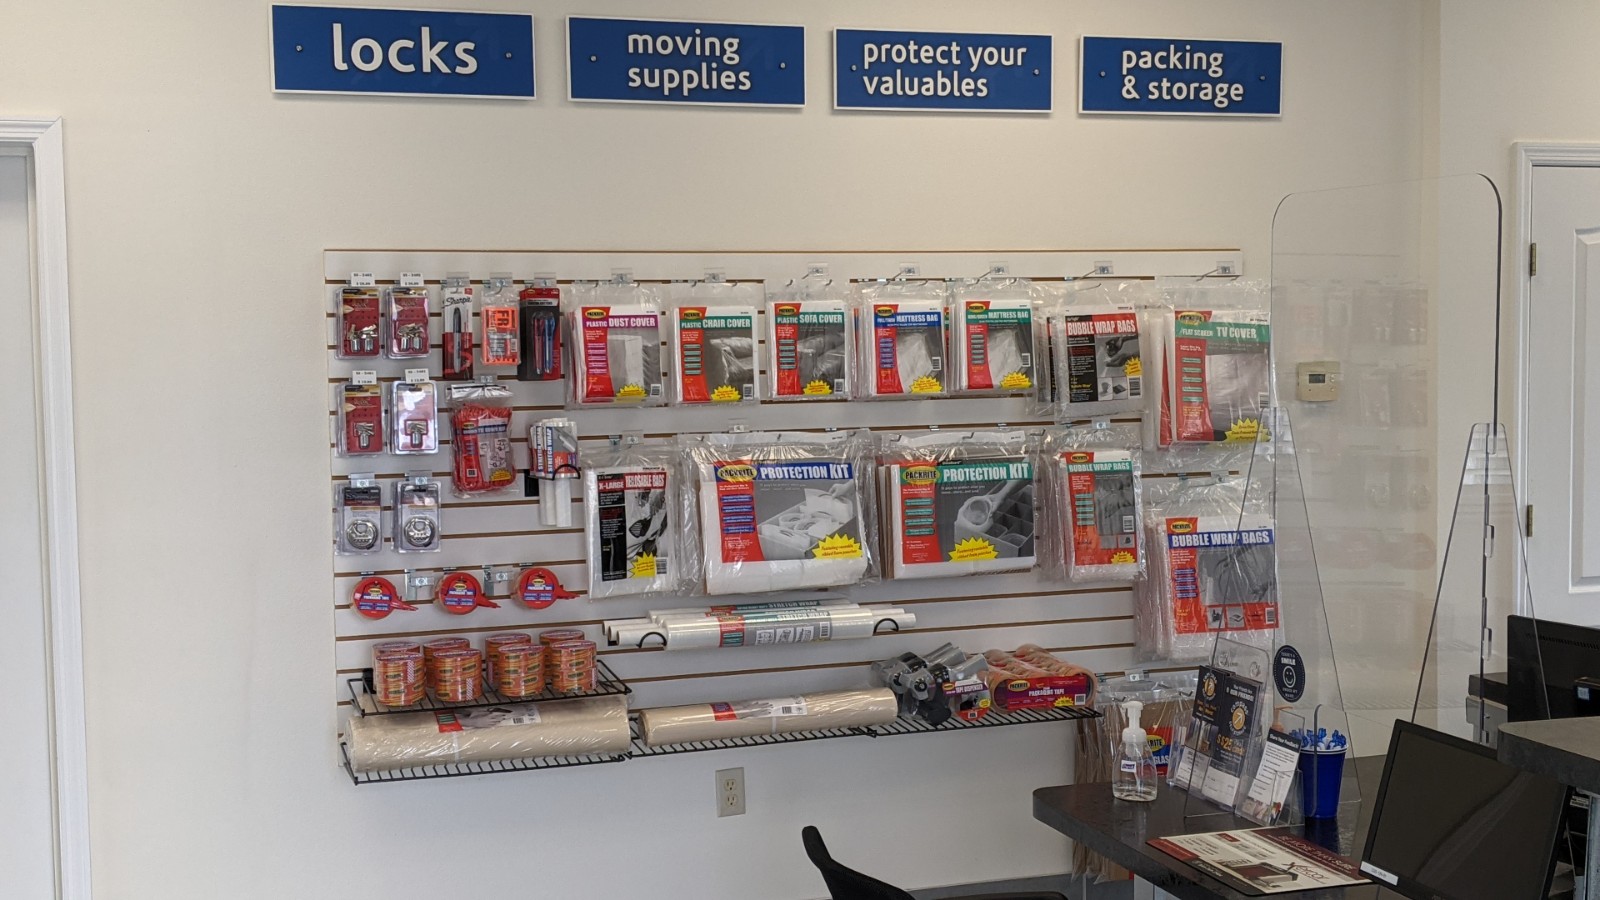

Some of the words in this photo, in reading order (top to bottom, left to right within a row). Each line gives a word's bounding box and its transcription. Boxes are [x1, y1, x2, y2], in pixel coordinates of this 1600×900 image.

[332, 22, 479, 75] locks
[627, 28, 741, 64] moving
[863, 40, 961, 68] protect
[966, 44, 1028, 72] your
[1121, 45, 1224, 78] packing
[628, 63, 752, 96] supplies
[862, 69, 989, 98] valuables
[1121, 76, 1140, 99] &
[1147, 78, 1244, 107] storage
[608, 317, 630, 327] DUST
[630, 317, 656, 327] COVER
[702, 318, 726, 328] CHAIR
[726, 318, 751, 328] COVER
[799, 314, 818, 323] SOFA
[818, 314, 843, 324] COVER
[896, 314, 926, 323] MATTRESS
[926, 313, 939, 322] BAG
[988, 311, 1017, 319] MATTRESS
[1066, 321, 1095, 336] BUBBLE
[1093, 320, 1116, 335] WRAP
[1116, 319, 1136, 333] BAGS
[1216, 326, 1228, 338] TV
[1228, 327, 1258, 339] COVER
[760, 465, 828, 480] PROTECTION
[829, 463, 850, 479] KIT
[905, 470, 937, 480] PACKRITE
[943, 466, 1008, 482] PROTECTION
[1009, 463, 1029, 479] KIT
[1068, 464, 1093, 472] BUBBLE
[1093, 463, 1113, 471] WRAP
[1113, 462, 1130, 470] BAGS
[598, 480, 625, 490] X-LARGE
[1171, 533, 1210, 547] BUBBLE
[1210, 532, 1240, 546] WRAP
[1241, 530, 1270, 544] BAGS
[1280, 657, 1296, 666] SMILE
